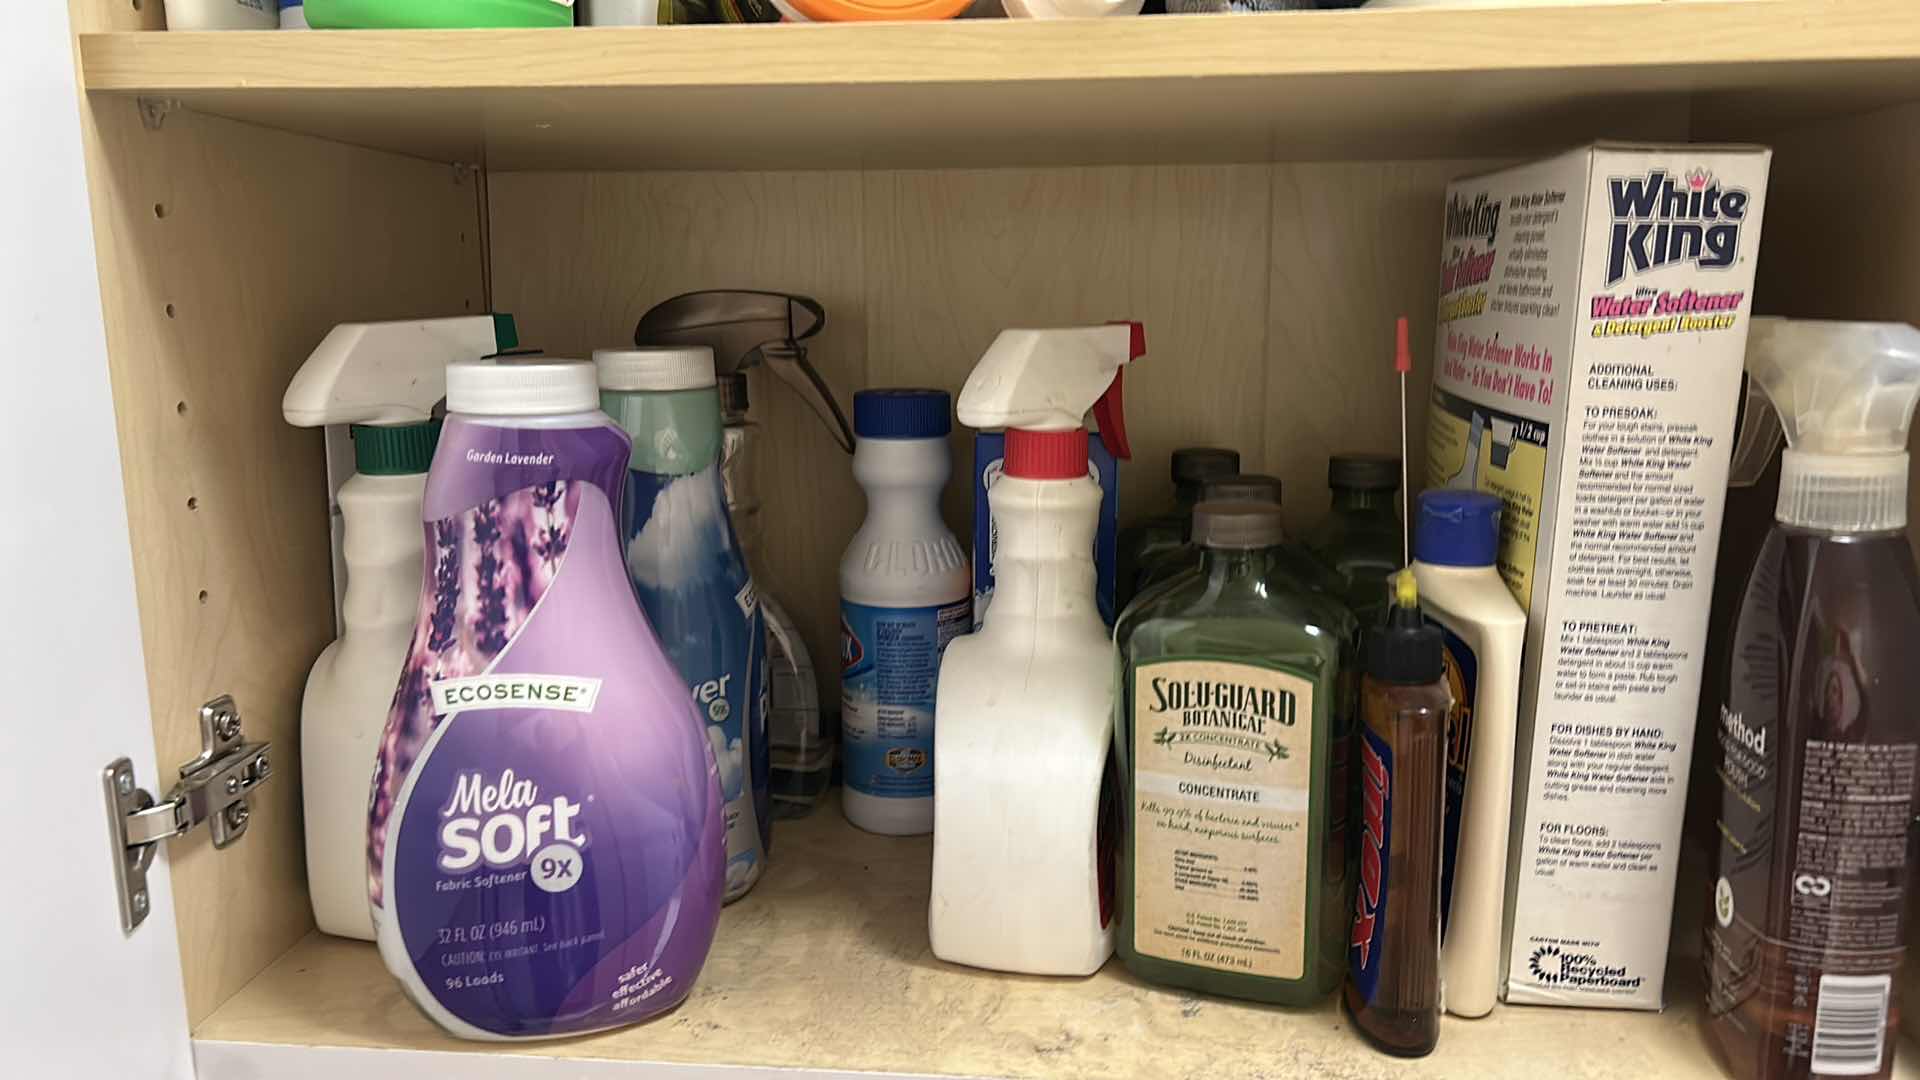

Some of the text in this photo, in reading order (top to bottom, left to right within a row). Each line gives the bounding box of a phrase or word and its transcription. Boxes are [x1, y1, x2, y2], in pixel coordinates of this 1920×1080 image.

[1607, 170, 1750, 222] White
[1605, 221, 1740, 288] King
[1591, 295, 1653, 320] Water
[1654, 288, 1744, 315] Softener
[1603, 317, 1679, 339] Detergent
[1678, 313, 1737, 332] Booster
[1513, 343, 1541, 372] Works
[1542, 346, 1553, 375] In
[1589, 363, 1654, 377] ADDITIONAL
[1492, 369, 1512, 396] Don't
[1513, 375, 1536, 403] Have
[1538, 378, 1553, 406] To!
[1588, 377, 1678, 392] CLEANING USES:
[1585, 406, 1658, 419] TO PRESOAK:
[1518, 420, 1533, 440] 1/2
[1669, 436, 1691, 444] White
[1694, 436, 1712, 447] King
[466, 449, 554, 465] Garden Lavender
[1582, 446, 1604, 454] Water
[1607, 446, 1641, 456] Softener
[1621, 459, 1643, 467] White
[1646, 460, 1665, 470] King
[1668, 460, 1691, 469] Water
[1579, 470, 1613, 479] Softener
[1573, 530, 1595, 538] White
[1597, 530, 1616, 541] King
[1618, 531, 1641, 539] Water
[1643, 532, 1677, 540] Softener
[1562, 621, 1638, 634] TO PRETREAT:
[1560, 646, 1583, 655] Water
[1585, 647, 1619, 656] Softener
[1627, 638, 1670, 648] White King
[444, 684, 578, 704] ECOSENSE
[1183, 709, 1267, 735] BOTANICAL
[1551, 723, 1664, 739] FOR DISHES BY HAND:
[1193, 734, 1261, 750] CONCENTRATE
[1634, 740, 1677, 752] White King
[1184, 751, 1253, 771] Disinfectant
[1549, 748, 1571, 757] Water
[1574, 749, 1607, 758] Softener
[1547, 769, 1649, 782] White King Water Softener
[443, 769, 538, 817] Mela
[1179, 782, 1261, 803] CONCENTRATE
[1539, 822, 1609, 837] FOR FLOORS:
[1538, 844, 1639, 860] White King Water Softener
[435, 868, 528, 892] Fabric Softener
[438, 928, 451, 945] 32
[455, 927, 466, 943] FL
[471, 925, 485, 940] OZ
[489, 920, 518, 939] (946
[1560, 953, 1598, 966] 100%
[618, 961, 649, 982] safer
[1560, 964, 1626, 977] Recycled
[445, 971, 504, 989] 96 Loads
[611, 968, 663, 999] effective
[1560, 972, 1640, 987] Paperboard
[612, 976, 673, 1011] affordable
